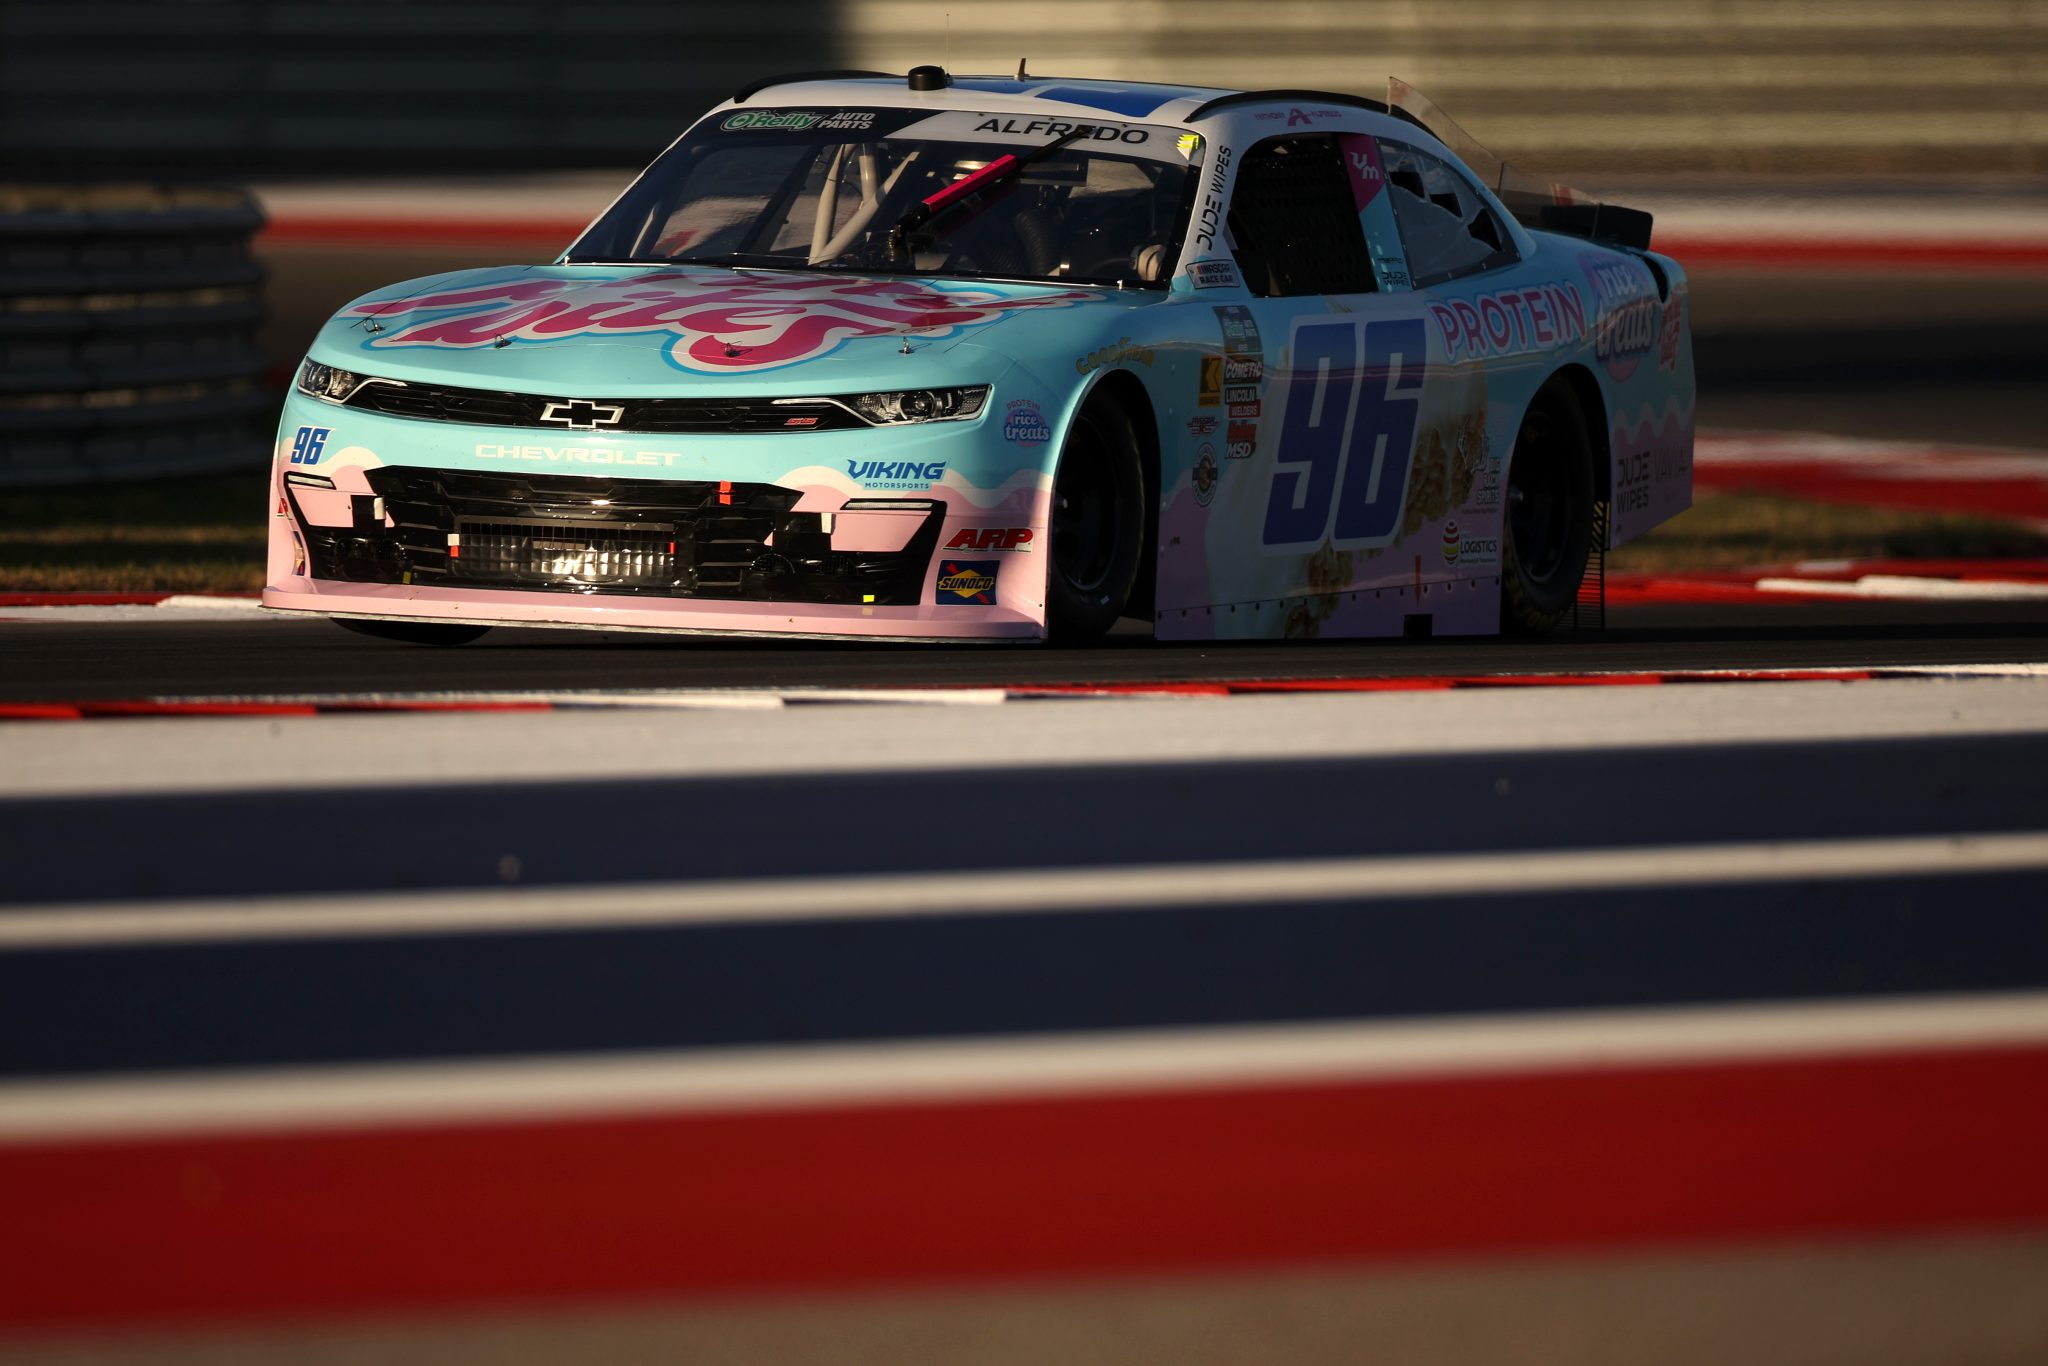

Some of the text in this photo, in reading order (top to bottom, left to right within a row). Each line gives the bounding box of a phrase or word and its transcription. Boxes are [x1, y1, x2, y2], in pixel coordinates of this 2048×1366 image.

[817, 121, 873, 129] PARTS
[974, 118, 1149, 144] ALFREDO
[1197, 145, 1232, 251] DUDE WIPES
[1381, 271, 1407, 280] DUDE
[1431, 283, 1587, 357] PROTEIN
[1596, 301, 1655, 359] treats
[1225, 360, 1263, 379] COMETIC
[1007, 399, 1041, 411] PROTEIN
[1226, 388, 1254, 403] LINCOLN
[1014, 411, 1038, 425] rice
[1231, 405, 1258, 417] WELDERS
[1005, 425, 1050, 440] treats
[1263, 318, 1427, 545] 96
[290, 426, 332, 465] 96
[475, 444, 682, 466] CHEVROLET
[1226, 442, 1252, 458] MSD
[847, 459, 947, 480] VIKING
[1617, 451, 1650, 488] DUDE
[864, 482, 930, 490] MOTORSPORTS
[1616, 485, 1650, 514] WIPES
[944, 528, 1034, 549] ARP
[1459, 541, 1498, 554] LOGISTICS
[940, 577, 994, 590] SUNOCO
